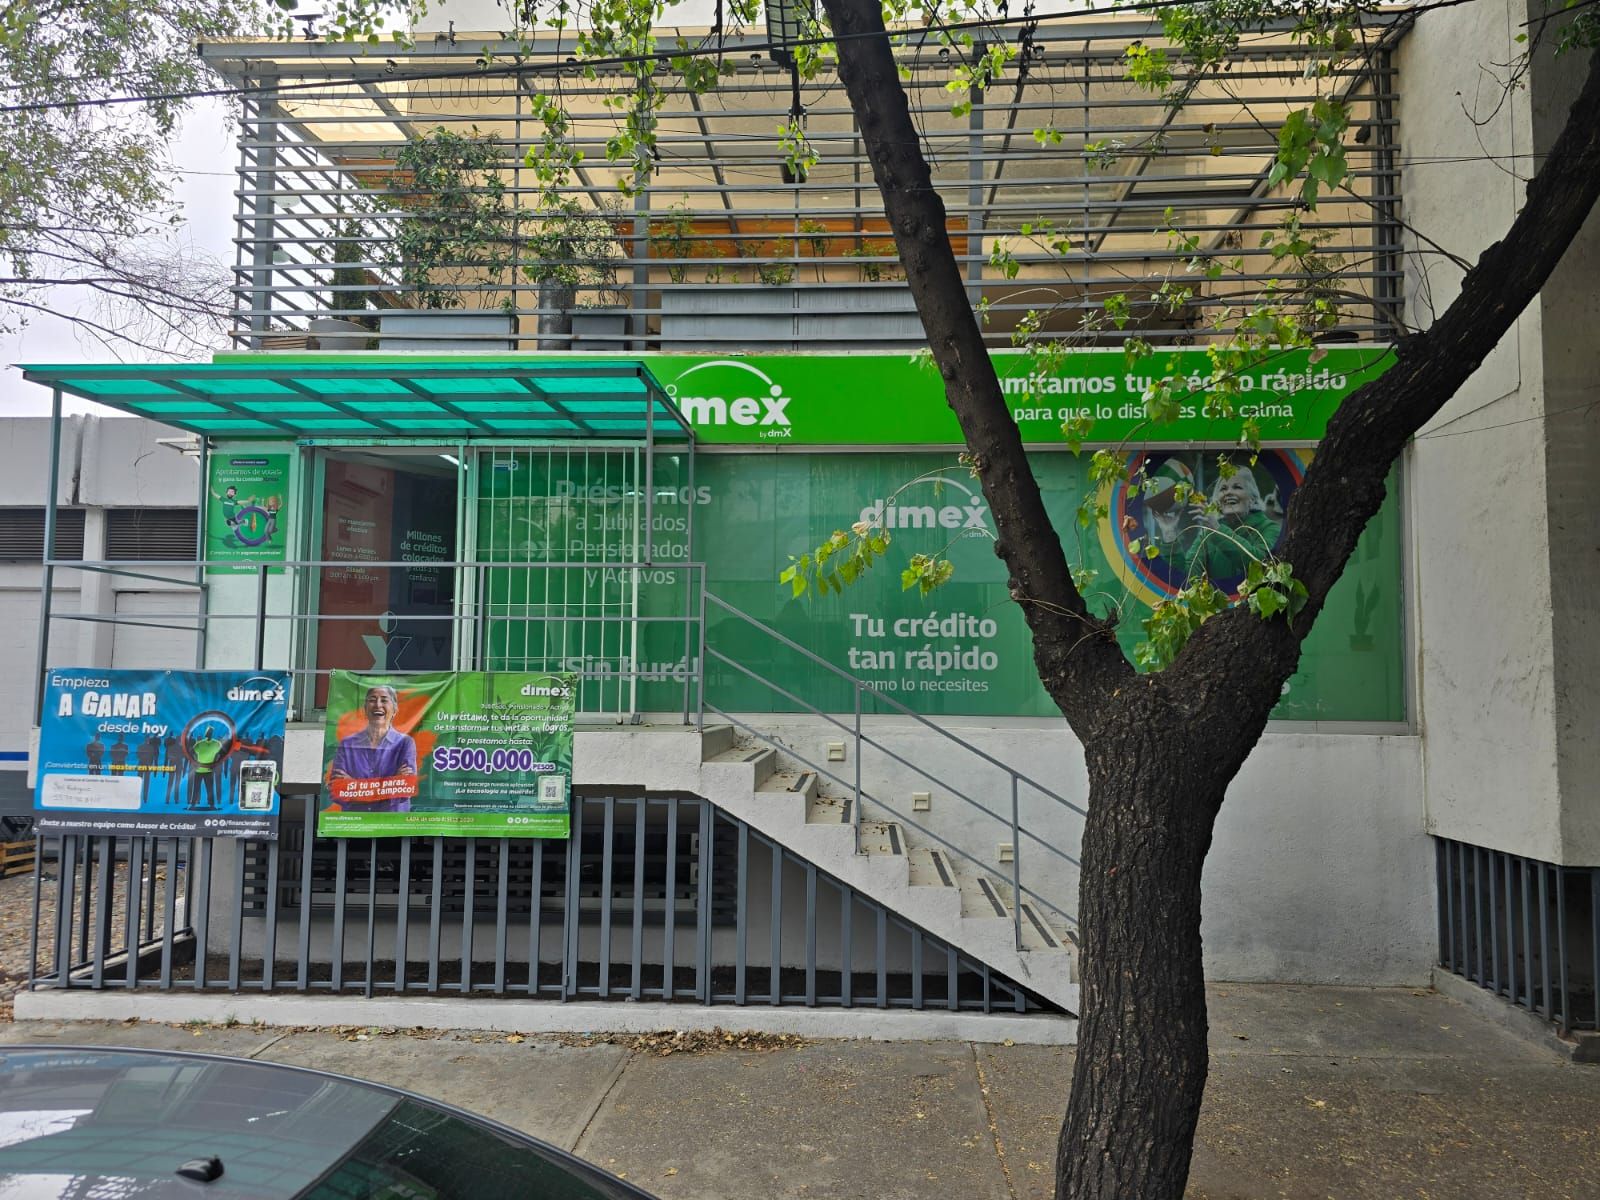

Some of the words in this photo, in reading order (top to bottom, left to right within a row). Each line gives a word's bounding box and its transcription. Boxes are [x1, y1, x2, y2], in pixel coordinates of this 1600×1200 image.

[1125, 373, 1152, 393] tu
[1261, 367, 1347, 396] rápido
[1013, 408, 1053, 423] para
[1058, 408, 1091, 424] que
[1097, 403, 1112, 419] lo
[1118, 403, 1196, 419] disfes
[1239, 401, 1294, 417] calma
[768, 428, 792, 438] dmX
[859, 495, 988, 529] dimex
[575, 516, 587, 530] a
[593, 512, 689, 535] Jubiados,
[406, 530, 442, 543] Millones
[400, 541, 411, 550] de
[413, 542, 448, 554] créditos
[587, 570, 598, 588] y
[849, 613, 886, 637] Tu
[893, 611, 998, 638] crédito
[848, 646, 896, 670] tan
[905, 643, 999, 676] rápido
[52, 675, 110, 689] Empieza
[902, 677, 915, 691] lo
[920, 678, 989, 691] necesites
[227, 685, 286, 701] dimex
[521, 683, 571, 697] dimex
[58, 693, 73, 717] A
[81, 691, 157, 719] GANAR
[437, 711, 449, 721] Un
[450, 710, 490, 723] préstamo,
[501, 713, 510, 721] da
[511, 713, 519, 721] la
[520, 713, 569, 723] oportunidad
[97, 721, 140, 734] desde
[142, 722, 168, 737] hoy
[434, 723, 444, 731] de
[445, 724, 490, 732] transformar
[491, 724, 503, 732] tus
[504, 722, 530, 733] metas
[543, 721, 570, 735] logros.
[467, 737, 508, 746] prestamos
[508, 738, 533, 746] hasta:
[433, 746, 533, 774] $500,000
[532, 762, 556, 771] PESOS
[382, 778, 408, 788] paras,
[339, 789, 375, 798] nosotros
[377, 785, 415, 796] tampoco!
[66, 820, 92, 828] nuestro
[93, 821, 116, 830] equipo
[159, 822, 168, 830] de
[169, 822, 197, 831] Crédito!
